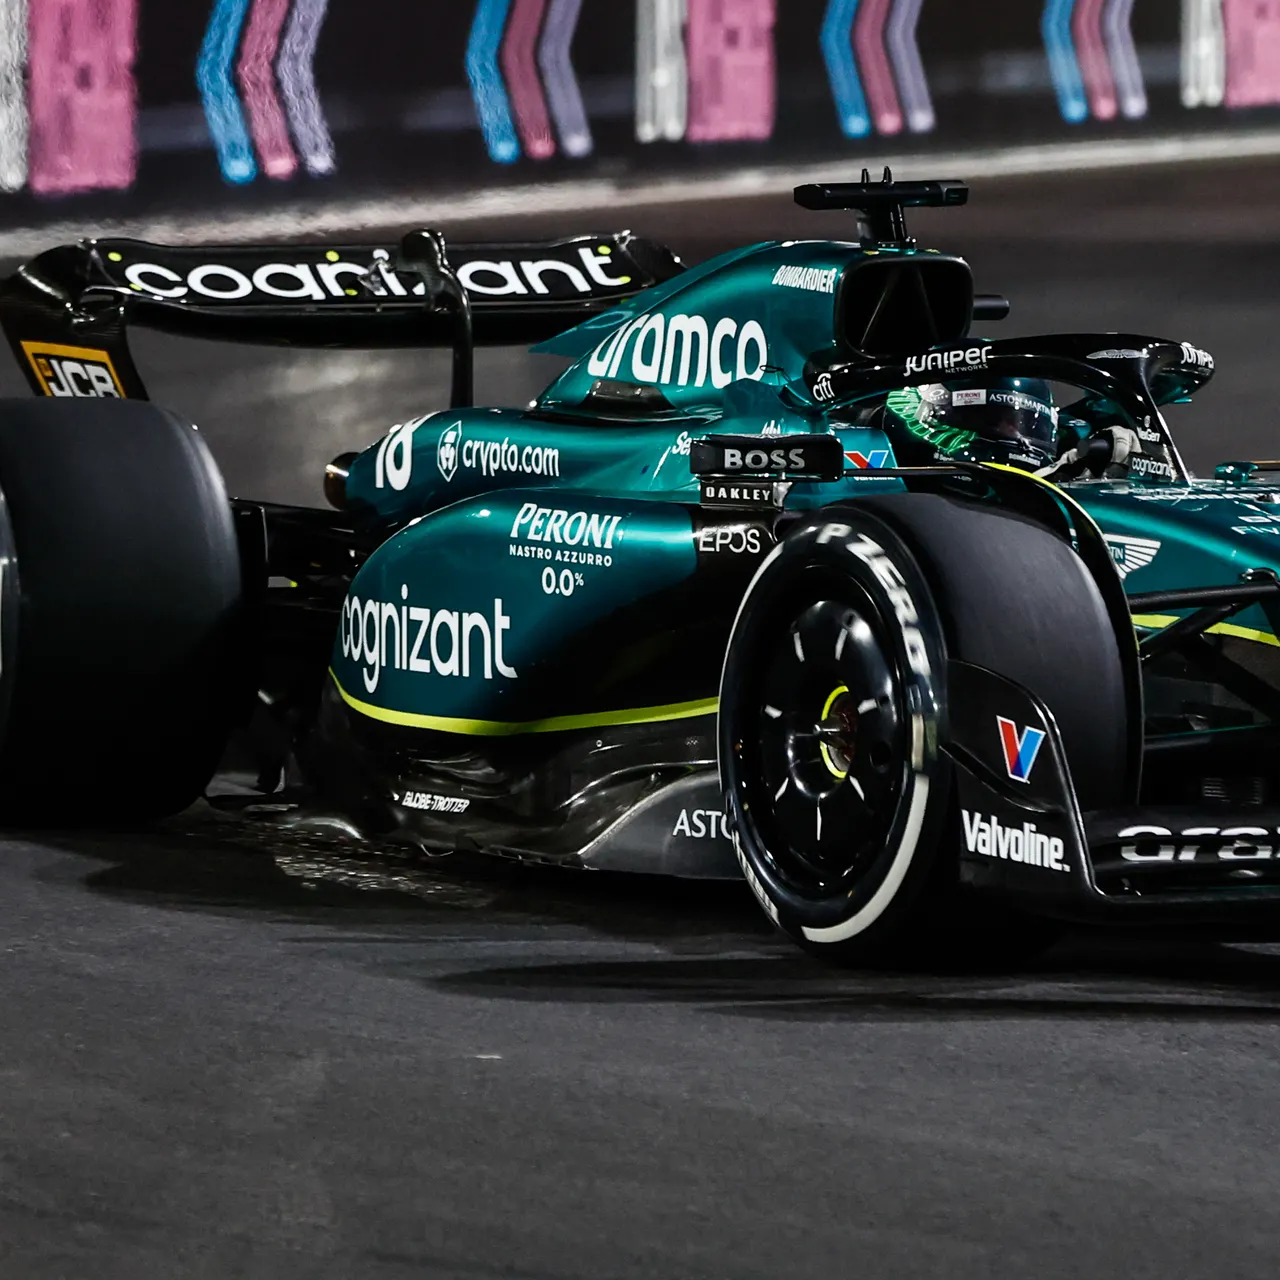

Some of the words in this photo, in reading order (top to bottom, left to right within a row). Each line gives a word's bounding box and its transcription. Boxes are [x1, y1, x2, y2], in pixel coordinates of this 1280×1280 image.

[124, 246, 630, 301] cogniant
[772, 265, 836, 293] BOMBARDIER
[587, 313, 767, 389] aramco
[47, 359, 120, 398] JCB
[945, 363, 989, 374] NETWORKS
[813, 373, 836, 402] citi
[462, 437, 560, 477] crypto.com
[724, 449, 805, 470] BOSS
[706, 486, 770, 501] OAKLEY
[510, 503, 622, 549] PERONI
[699, 527, 761, 554] EPOS
[510, 544, 552, 561] NASTRO
[555, 550, 613, 567] AZZURRO
[542, 567, 585, 597] 0.0%
[817, 522, 852, 544] P
[845, 532, 931, 677] ZERO
[341, 583, 518, 694] cognizant
[402, 791, 470, 813] GLOBE-TROTTER
[672, 808, 732, 840] ASTO
